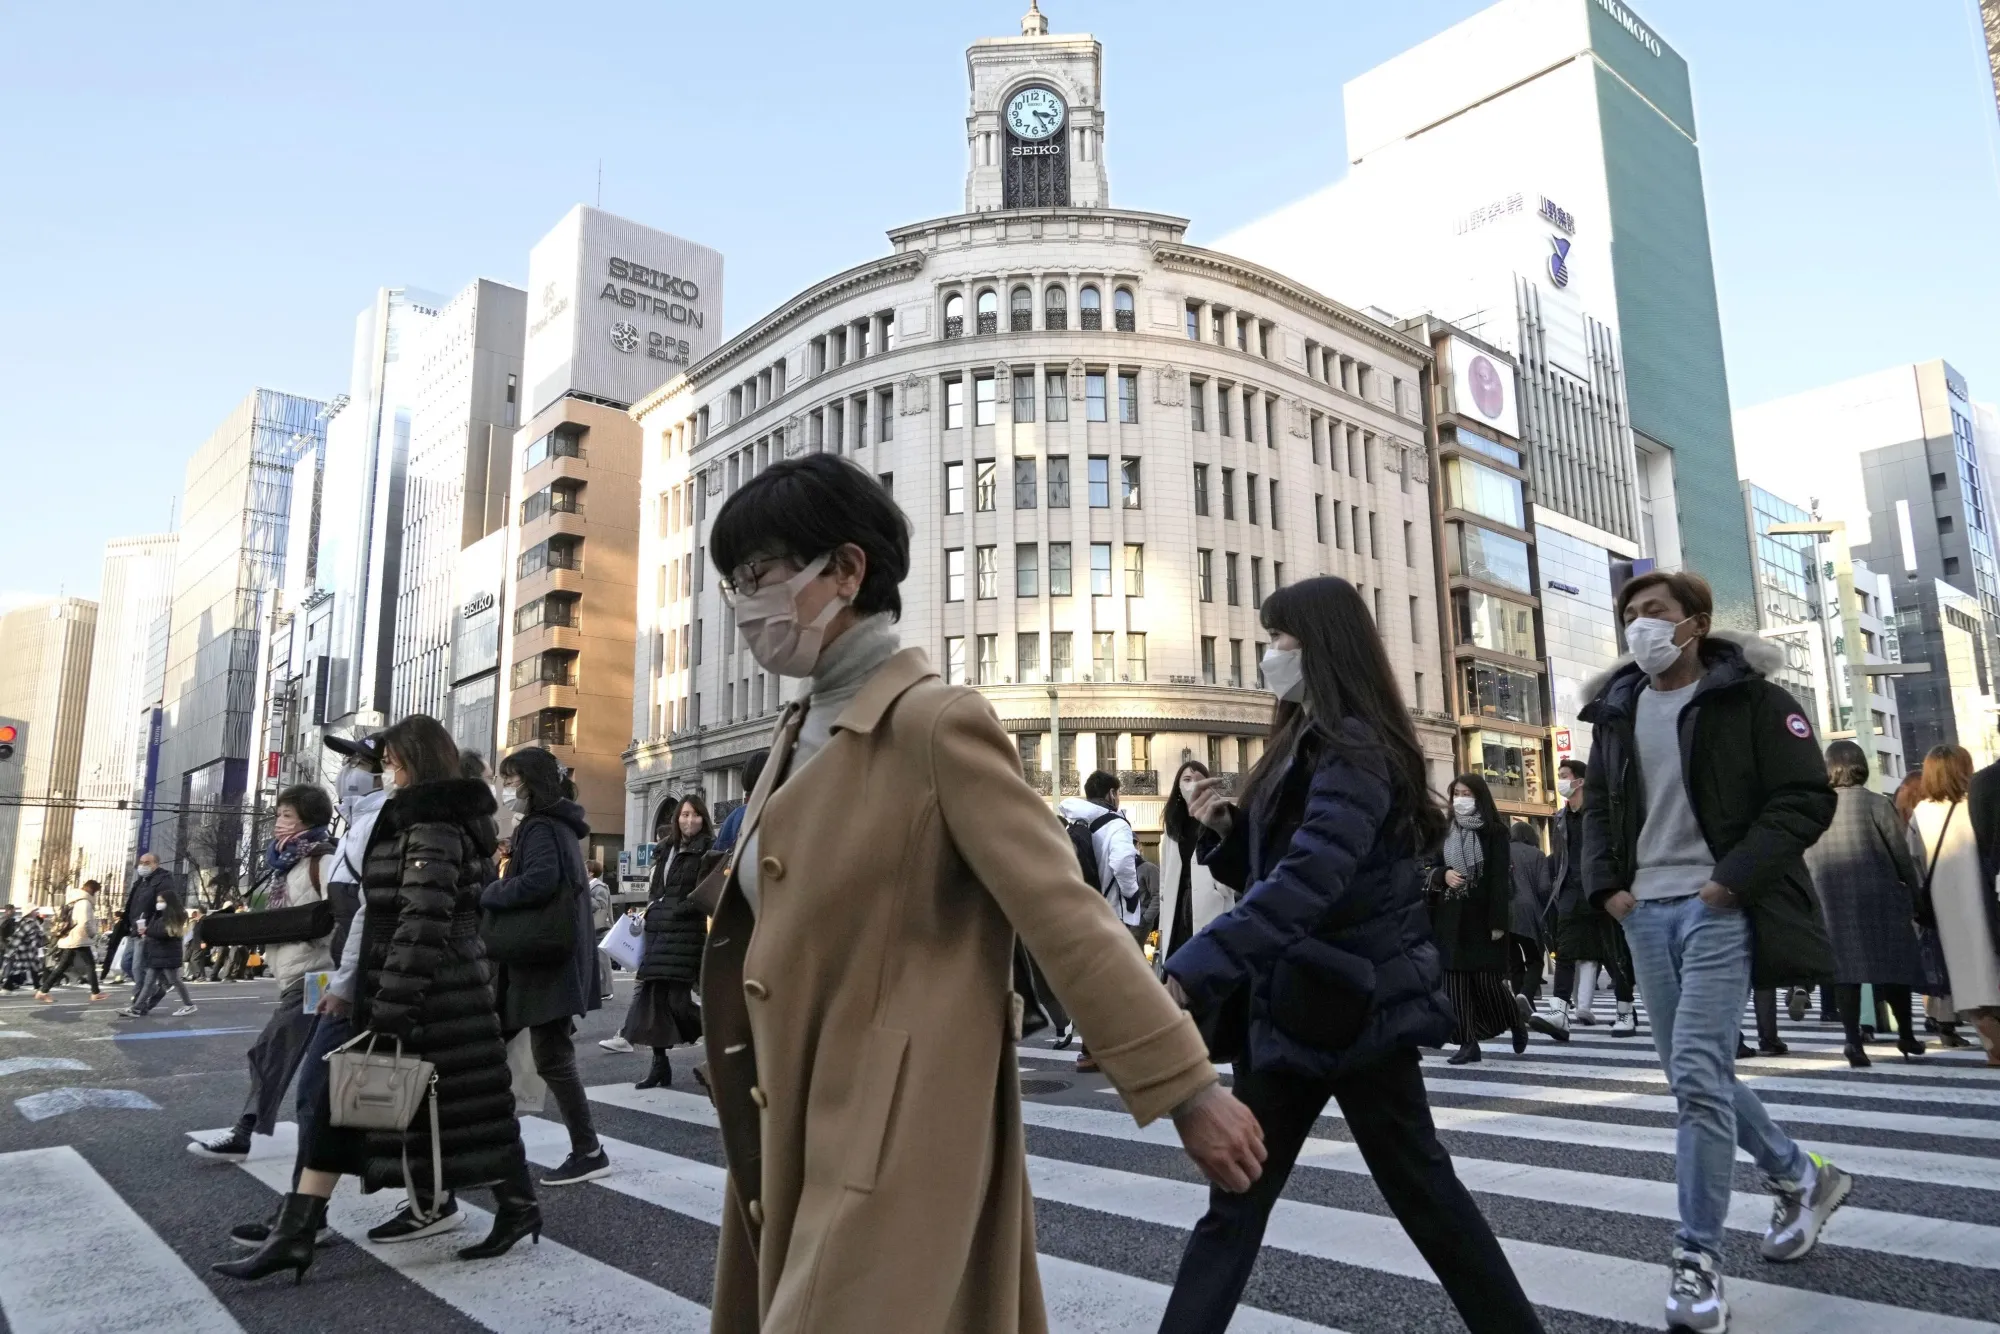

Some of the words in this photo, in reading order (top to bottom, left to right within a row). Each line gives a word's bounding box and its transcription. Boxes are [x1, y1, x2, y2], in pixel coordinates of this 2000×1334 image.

[1593, 0, 1661, 58] IKIMOTO
[1031, 92, 1039, 101] 12
[1015, 102, 1022, 110] 10
[1048, 100, 1055, 108] 2
[1012, 111, 1019, 119] 9
[1052, 109, 1058, 117] 3
[1015, 118, 1022, 127] 8
[1048, 118, 1055, 126] 4
[1024, 124, 1031, 133] 7
[1032, 126, 1039, 135] 6
[1012, 145, 1060, 156] SEIKO
[608, 257, 699, 301] SEIKO
[412, 304, 441, 318] TENS
[599, 283, 704, 330] ASTRON
[648, 331, 690, 355] GPS
[646, 347, 689, 367] SOLAR
[463, 593, 494, 619] SEIKO
[1883, 614, 1900, 664] 教文館ビ
